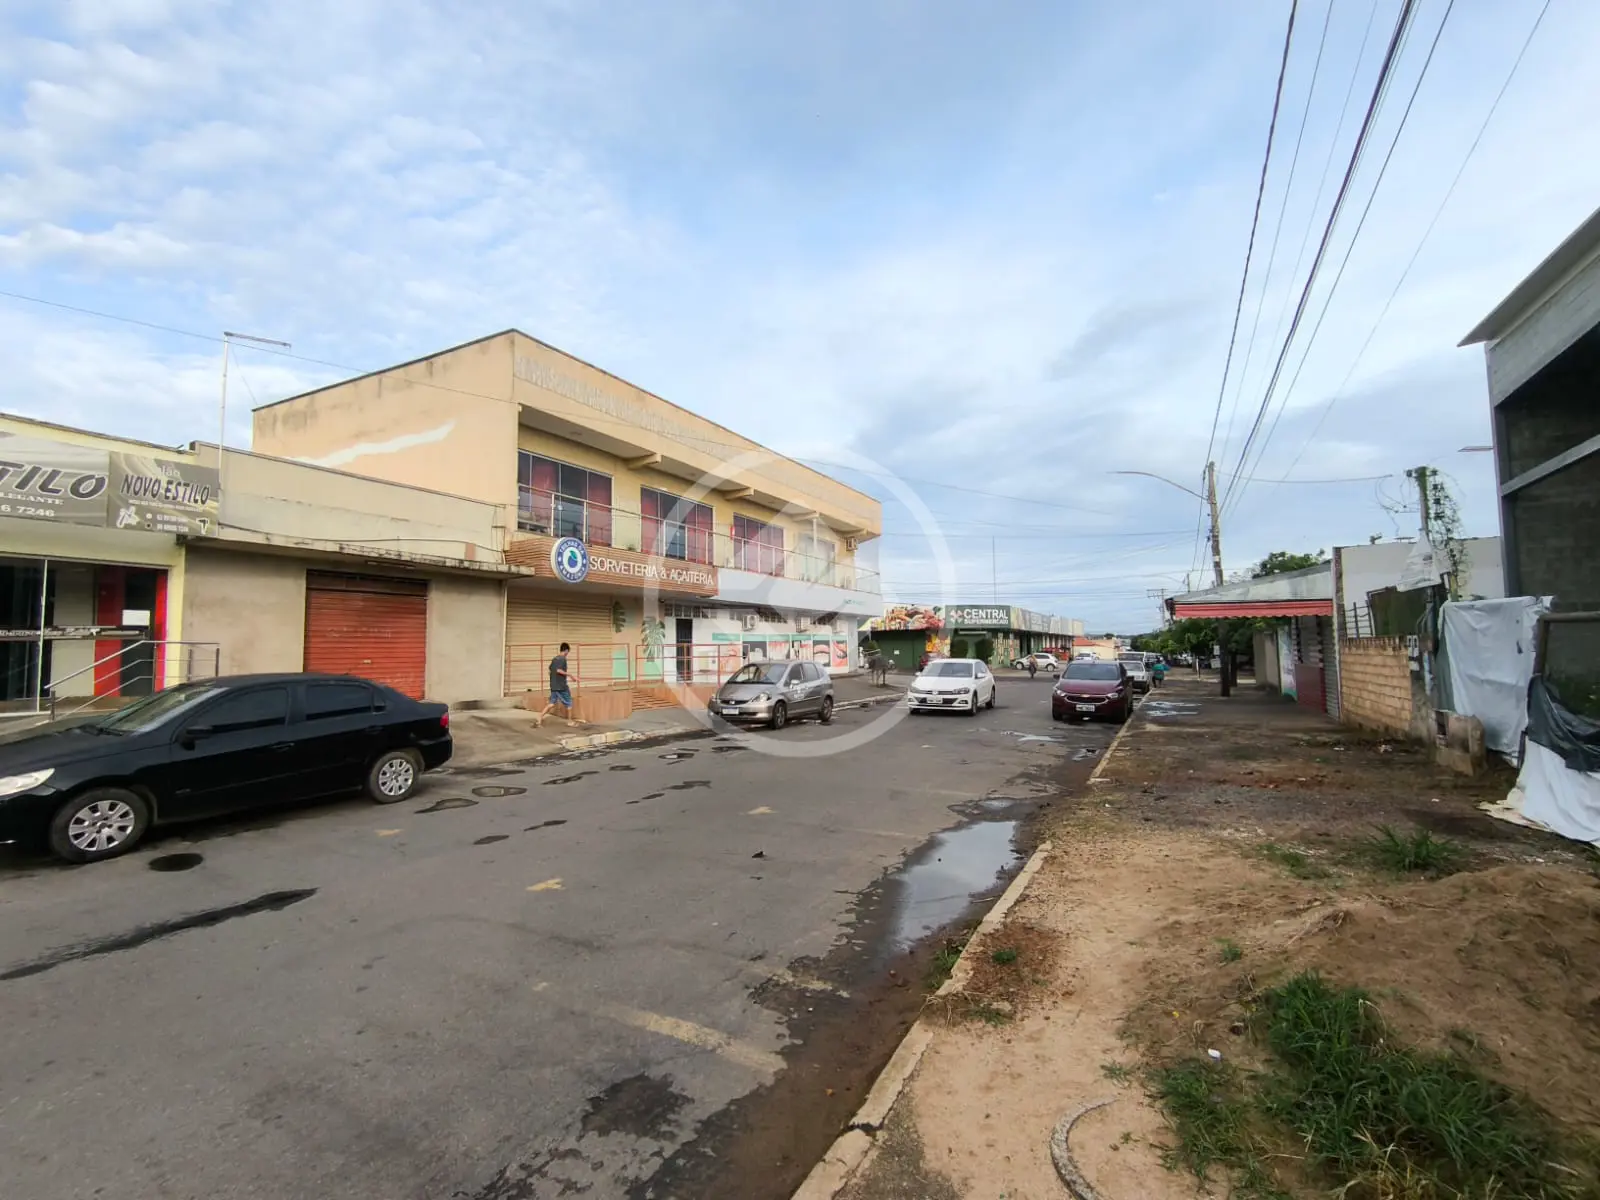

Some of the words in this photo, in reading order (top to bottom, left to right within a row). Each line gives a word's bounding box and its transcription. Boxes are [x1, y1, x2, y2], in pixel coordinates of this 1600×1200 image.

[120, 474, 162, 499] NOVO
[164, 479, 211, 505] ESTILO
[16, 505, 55, 517] 7246
[589, 556, 659, 579] SORVETERIA
[660, 569, 667, 579] &
[670, 568, 714, 585] AÇAITERIA
[963, 608, 1009, 619] CENTRAL
